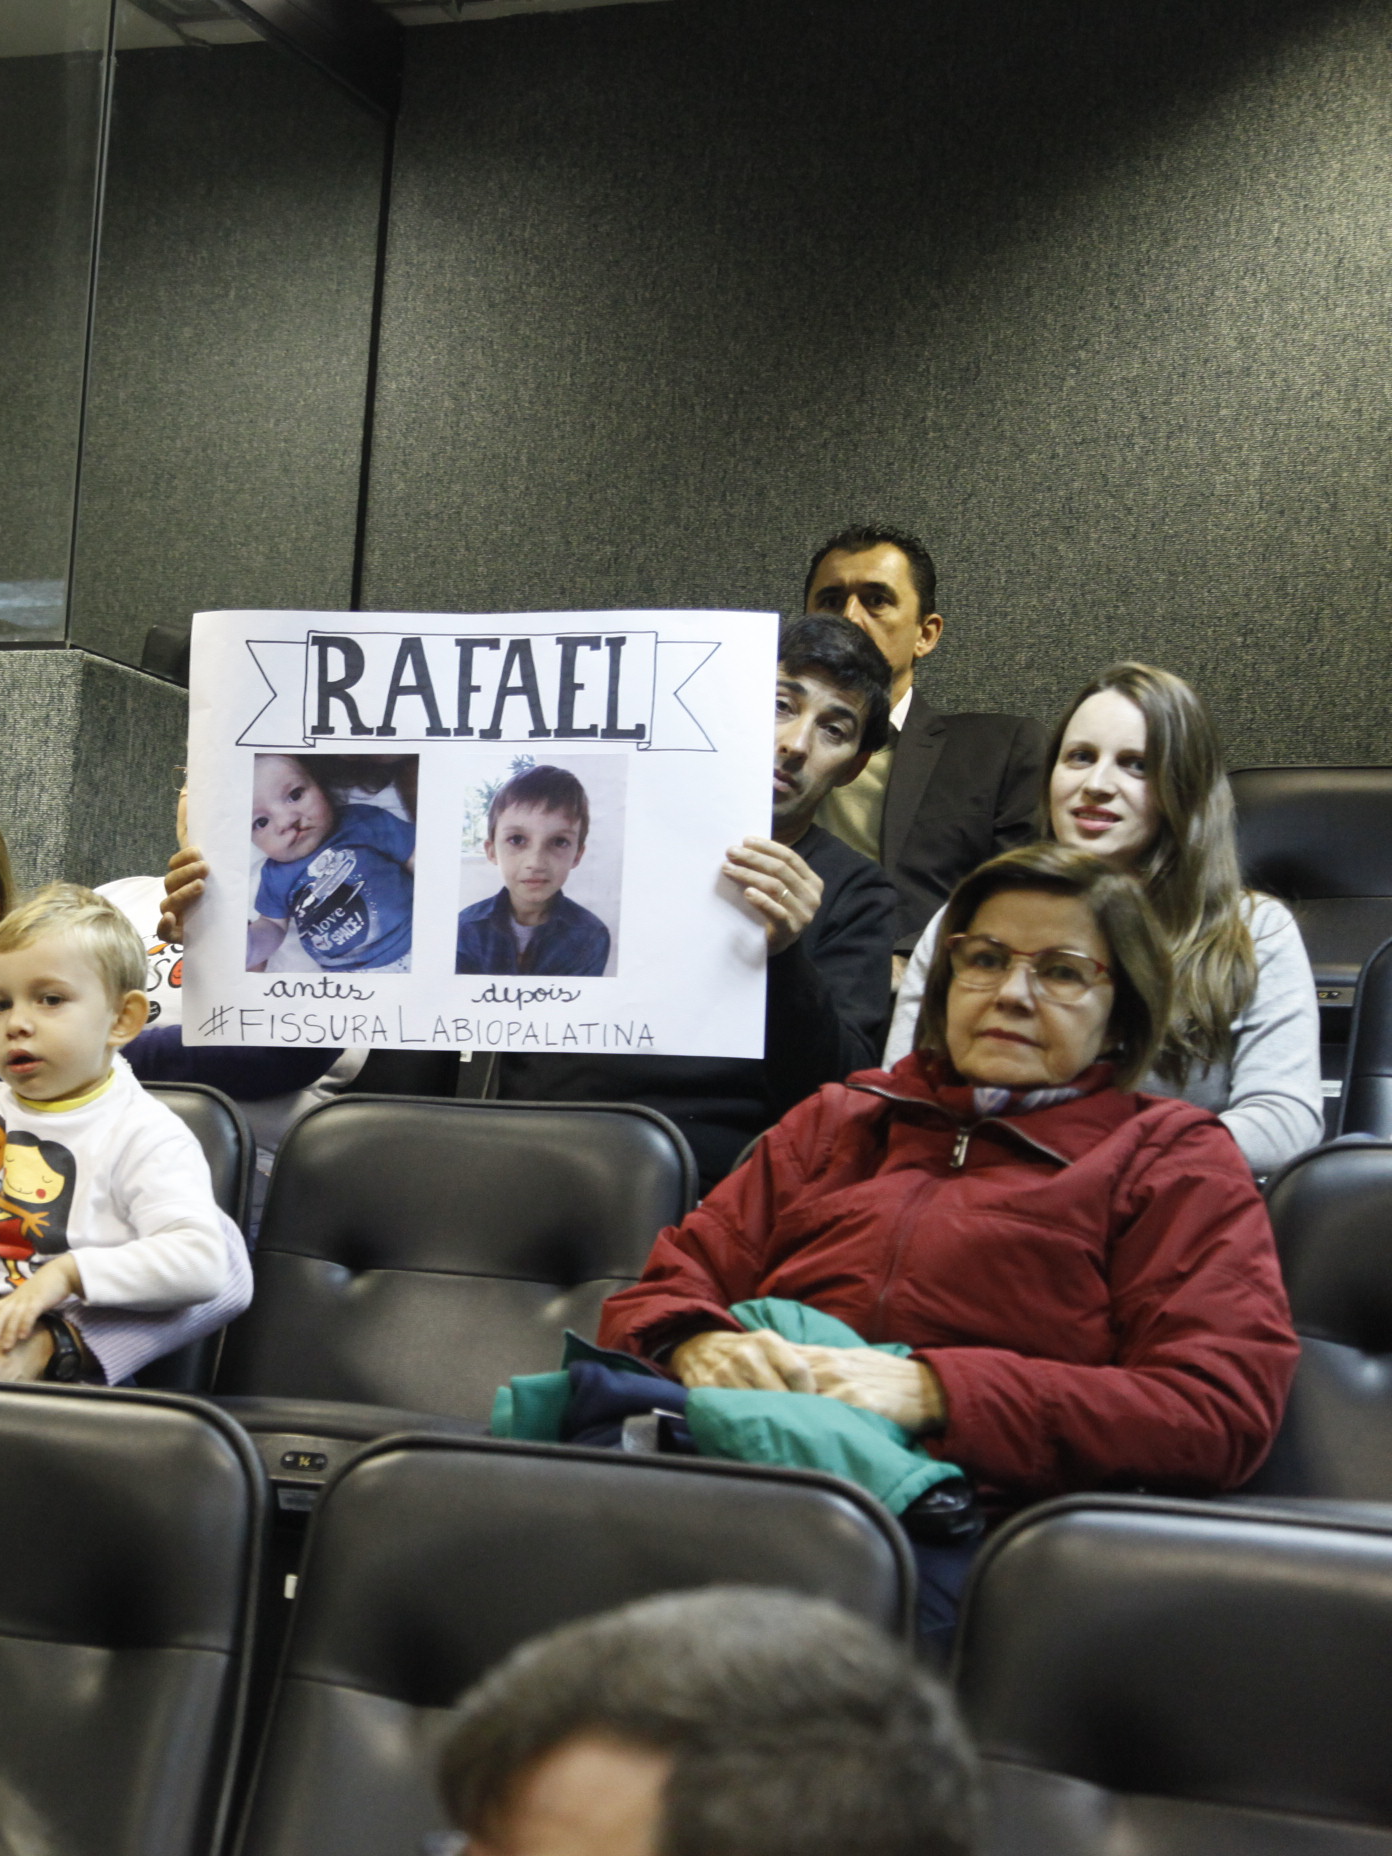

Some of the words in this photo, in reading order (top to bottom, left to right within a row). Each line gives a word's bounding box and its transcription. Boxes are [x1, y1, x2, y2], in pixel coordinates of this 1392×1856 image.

[310, 635, 646, 740] RAFAEL
[263, 976, 375, 1000] antes
[471, 983, 581, 1010] depois
